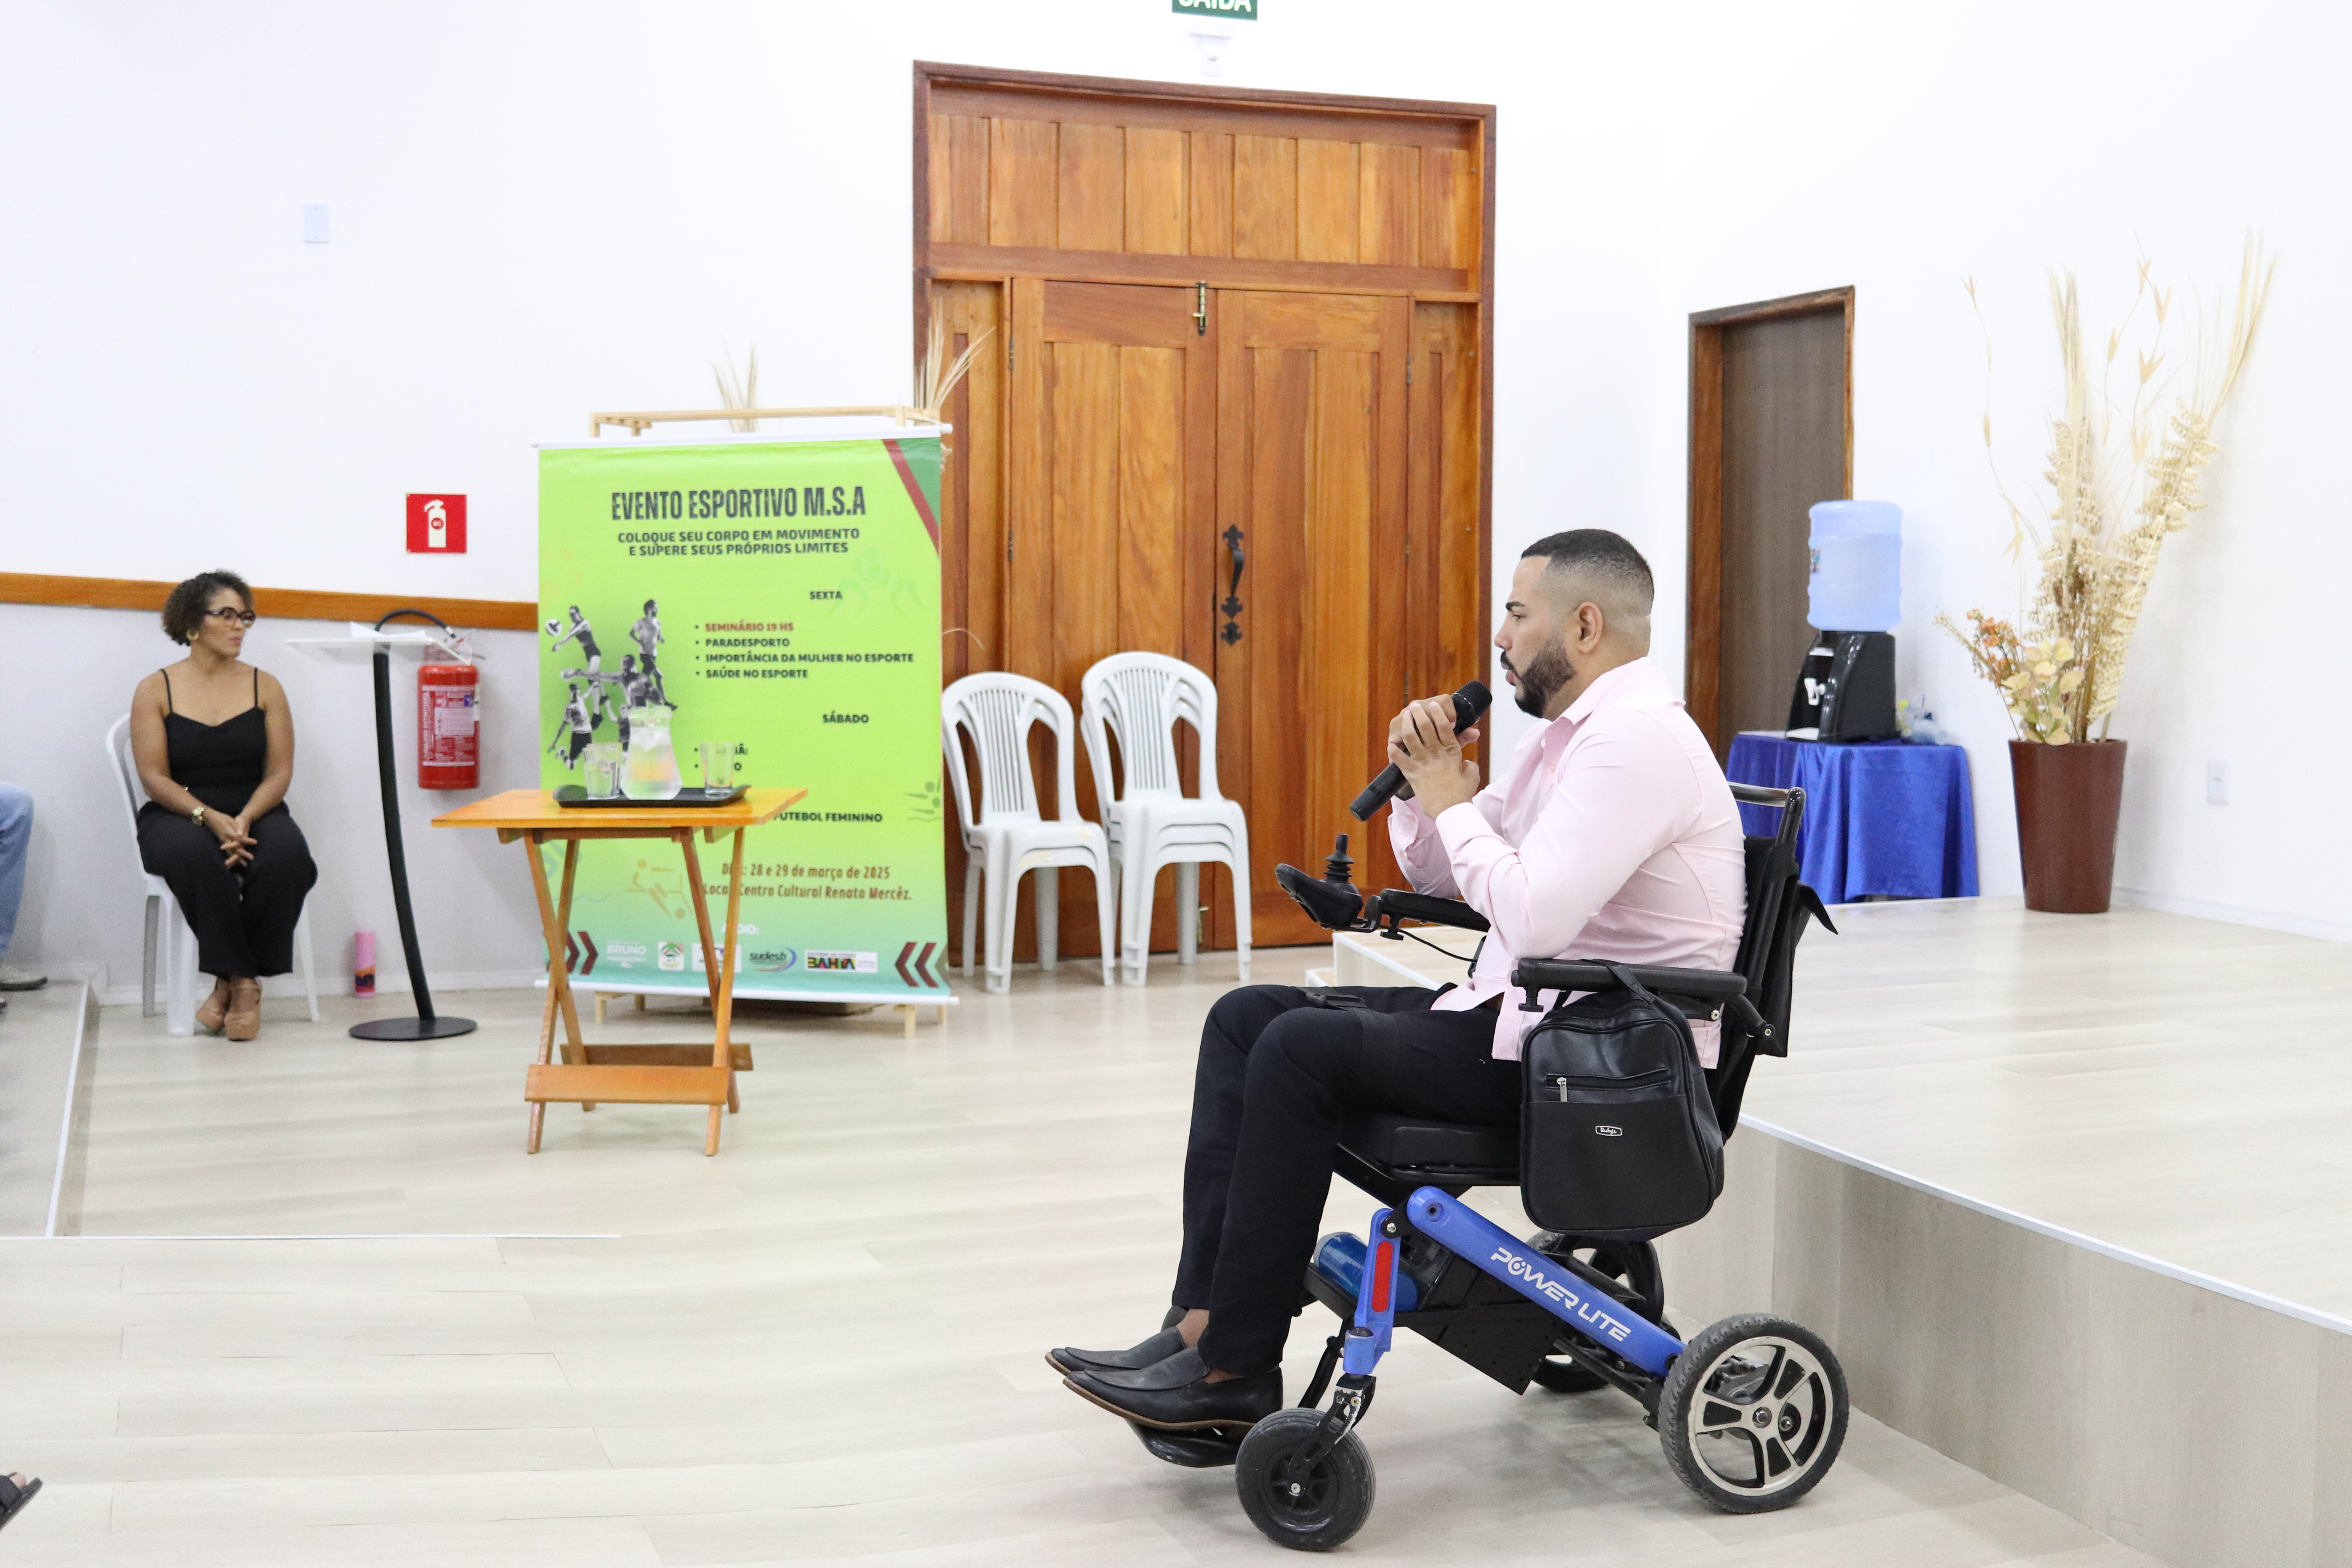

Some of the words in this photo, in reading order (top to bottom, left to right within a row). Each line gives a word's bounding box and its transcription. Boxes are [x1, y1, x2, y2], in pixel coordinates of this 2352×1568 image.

[612, 491, 682, 520] EVENTO
[689, 488, 797, 519] ESPORTIVO
[804, 486, 866, 516] M.S.A
[618, 532, 675, 543] COLOQUE
[679, 532, 703, 542] SEU
[707, 531, 749, 541] CORPO
[753, 530, 772, 540] EM
[776, 529, 860, 539] MOVIMENTO
[629, 546, 636, 555] E
[640, 545, 688, 555] SUPERE
[691, 545, 723, 555] SEUS
[727, 542, 791, 554] PRÓPRIOS
[795, 543, 848, 554] LIMITES
[810, 591, 842, 600] SEXTA
[706, 619, 764, 632] SEMINÁRIO
[780, 623, 794, 631] HS
[706, 639, 790, 647] PARADESPORTO
[706, 650, 779, 662] IMPORTÂNCIA
[865, 653, 914, 662] ESPORTE
[706, 666, 740, 678] SAÚDE
[762, 670, 808, 678] ESPORTE
[823, 710, 869, 723] SÁBADO
[826, 813, 883, 822] FEMININO
[751, 864, 763, 876] 28
[766, 866, 772, 876] e
[776, 864, 789, 877] 29
[791, 865, 804, 877] de
[808, 868, 843, 882] março
[846, 866, 860, 878] de
[864, 866, 890, 879] 2025
[704, 884, 729, 895] Loca
[778, 884, 822, 898] Cultural
[825, 886, 866, 899] Renato
[721, 924, 759, 935] OIO:
[607, 944, 647, 955] BRUNO
[750, 951, 786, 961] sudesb
[1490, 1247, 1579, 1310] POWER
[1578, 1302, 1632, 1341] LITE
